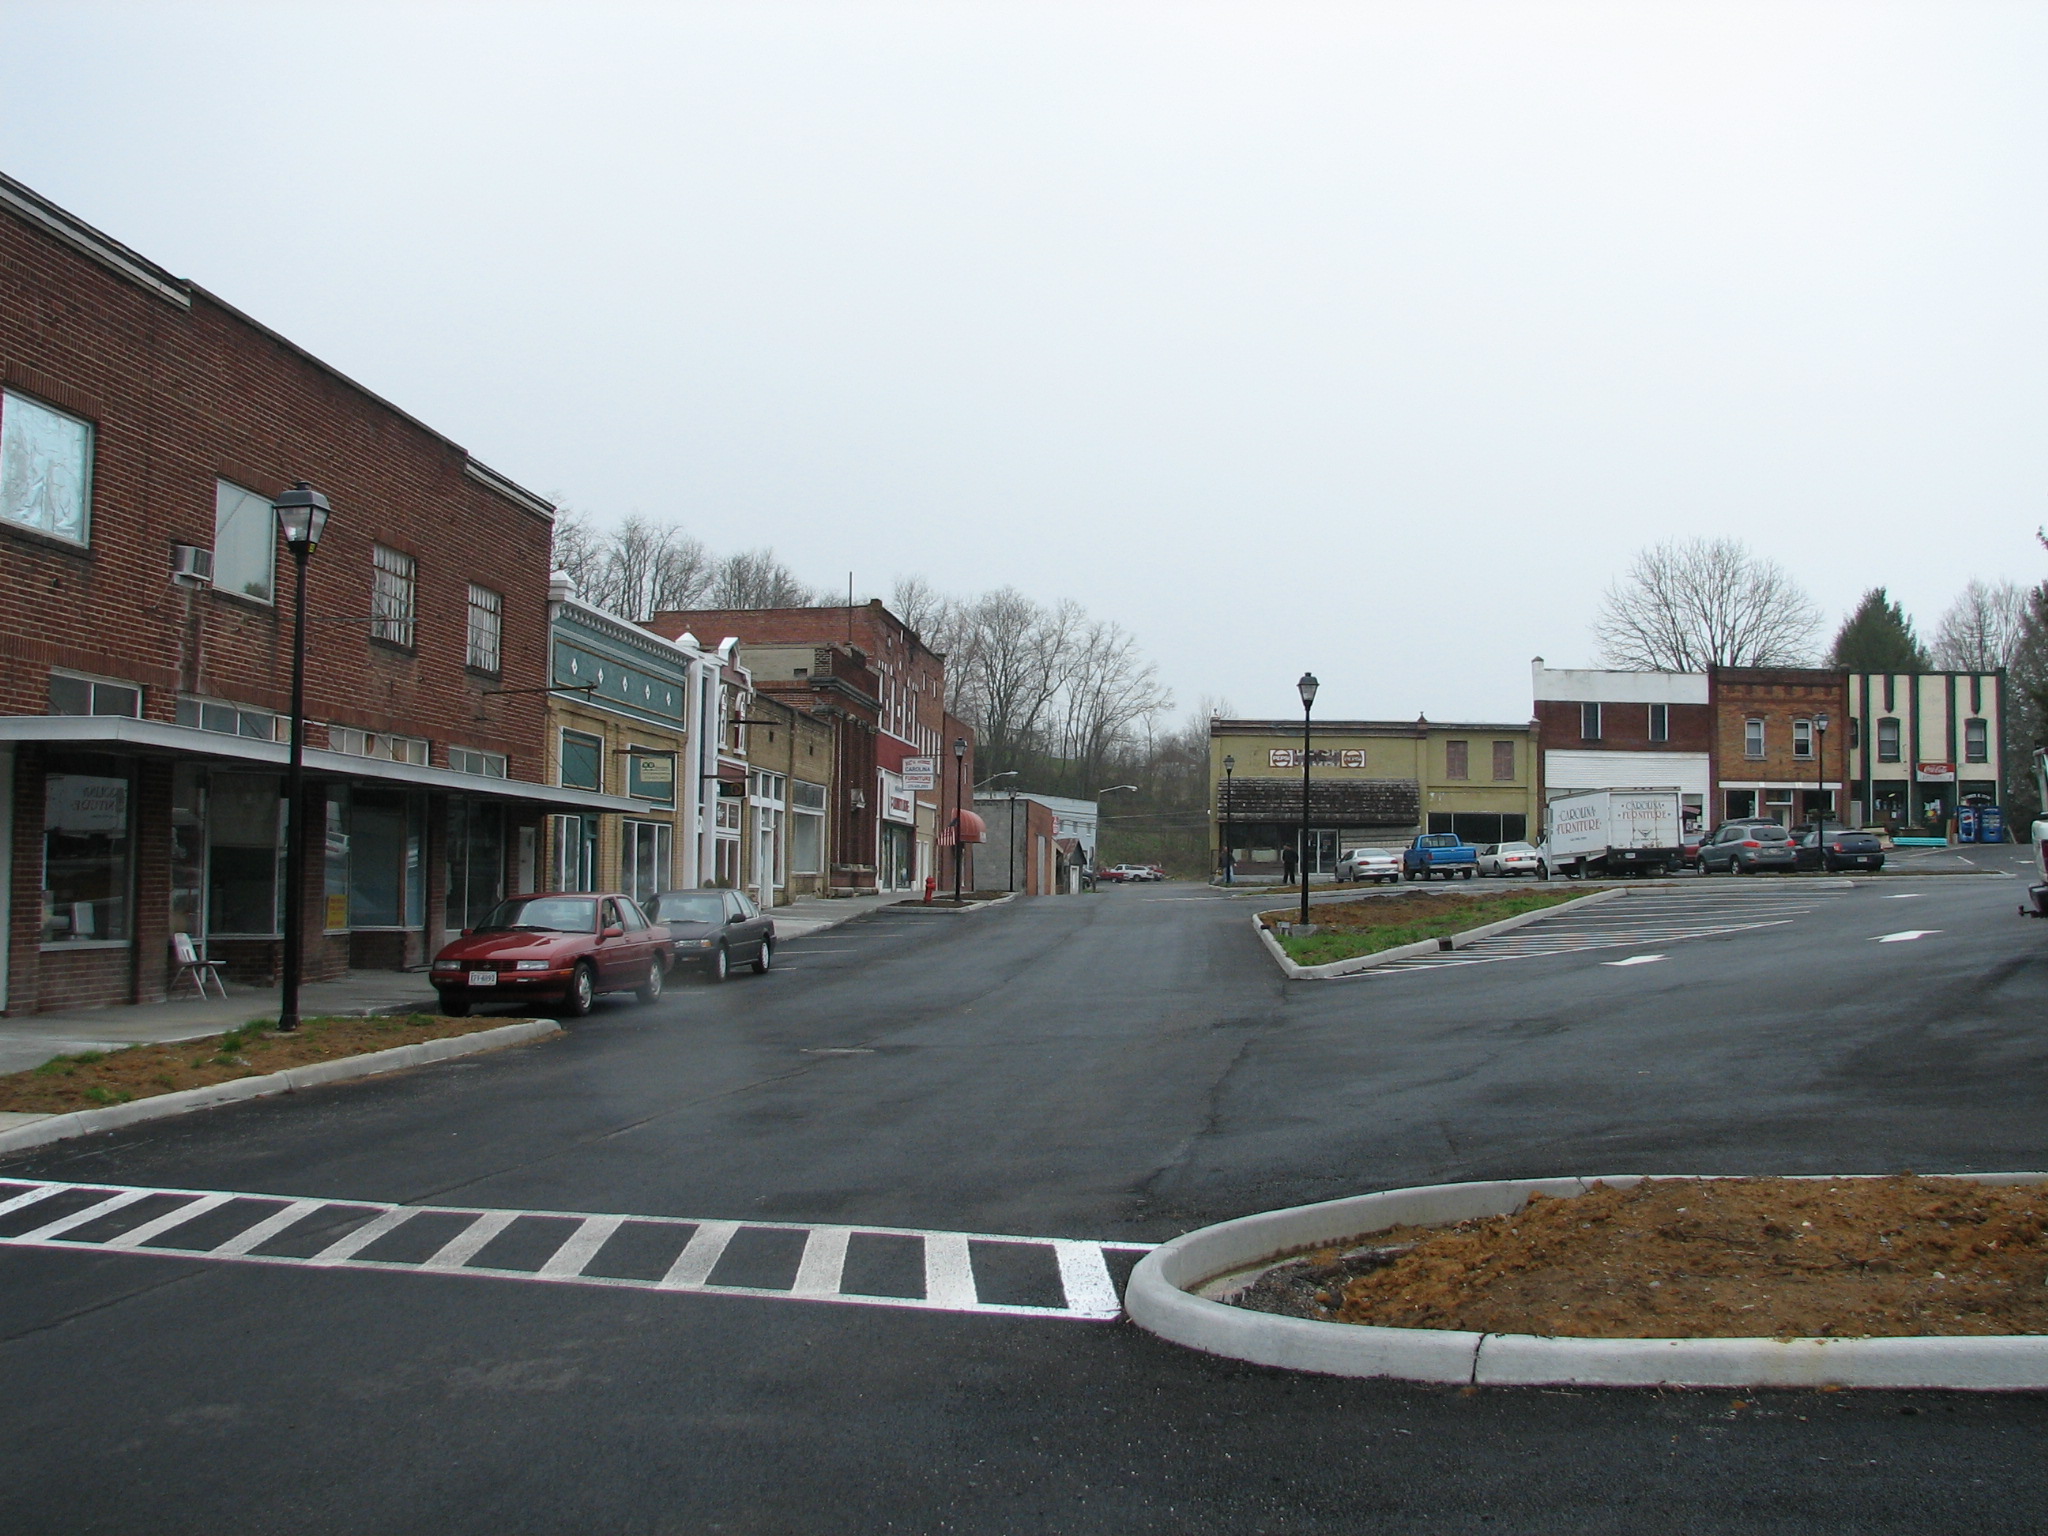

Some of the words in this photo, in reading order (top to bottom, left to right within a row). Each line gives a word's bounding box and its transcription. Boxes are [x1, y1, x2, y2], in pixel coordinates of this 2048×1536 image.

[1625, 800, 1662, 811] CAROLINA
[1560, 805, 1595, 821] CAROLINA
[1622, 810, 1667, 820] FURNITURE
[1557, 819, 1600, 834] FURNITURE
